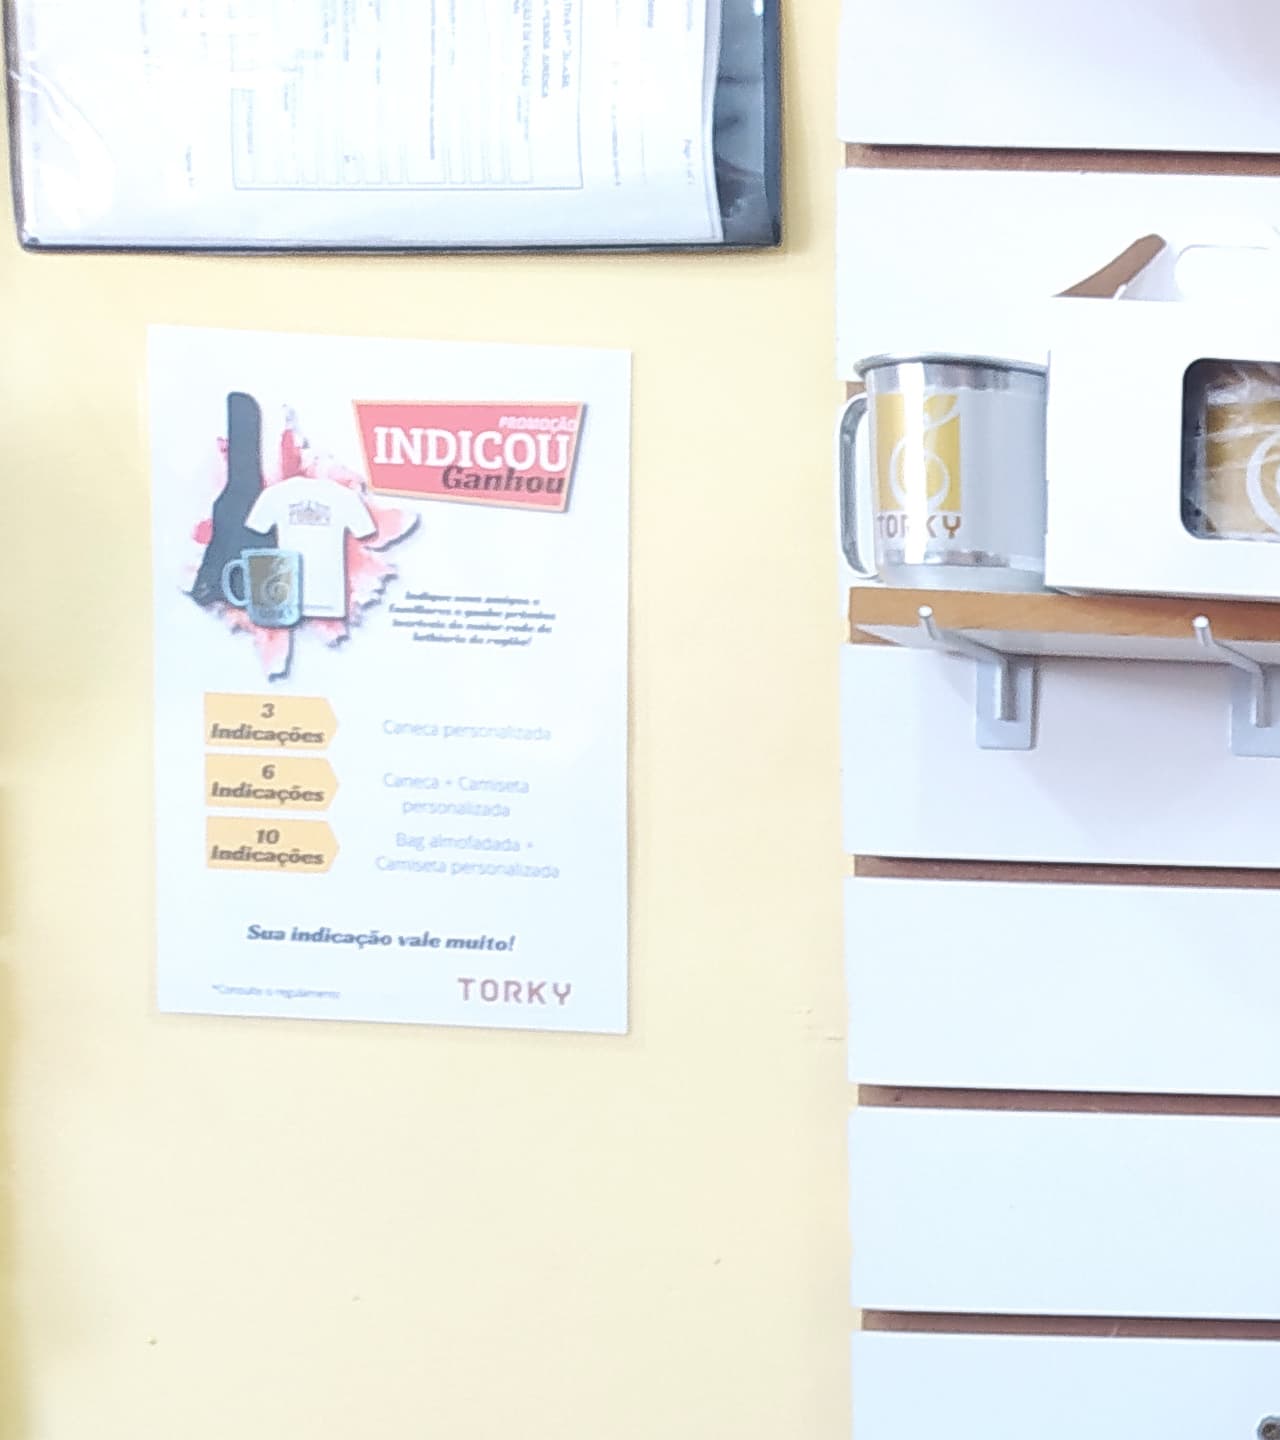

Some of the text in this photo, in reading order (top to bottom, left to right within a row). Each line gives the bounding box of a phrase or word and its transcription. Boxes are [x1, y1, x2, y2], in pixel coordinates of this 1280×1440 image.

[373, 426, 570, 473] INDICOU
[442, 465, 566, 495] Ganhou
[261, 703, 275, 718] 3
[211, 723, 325, 746] Indicações
[261, 764, 276, 780] 6
[211, 781, 325, 805] Indicações
[458, 776, 530, 794] Camiseta
[256, 829, 281, 844] 10
[211, 844, 325, 868] Indicações
[375, 855, 448, 874] Camiseta
[247, 924, 516, 952] Sua indicação vale muito!
[456, 977, 572, 1005] TORKY
